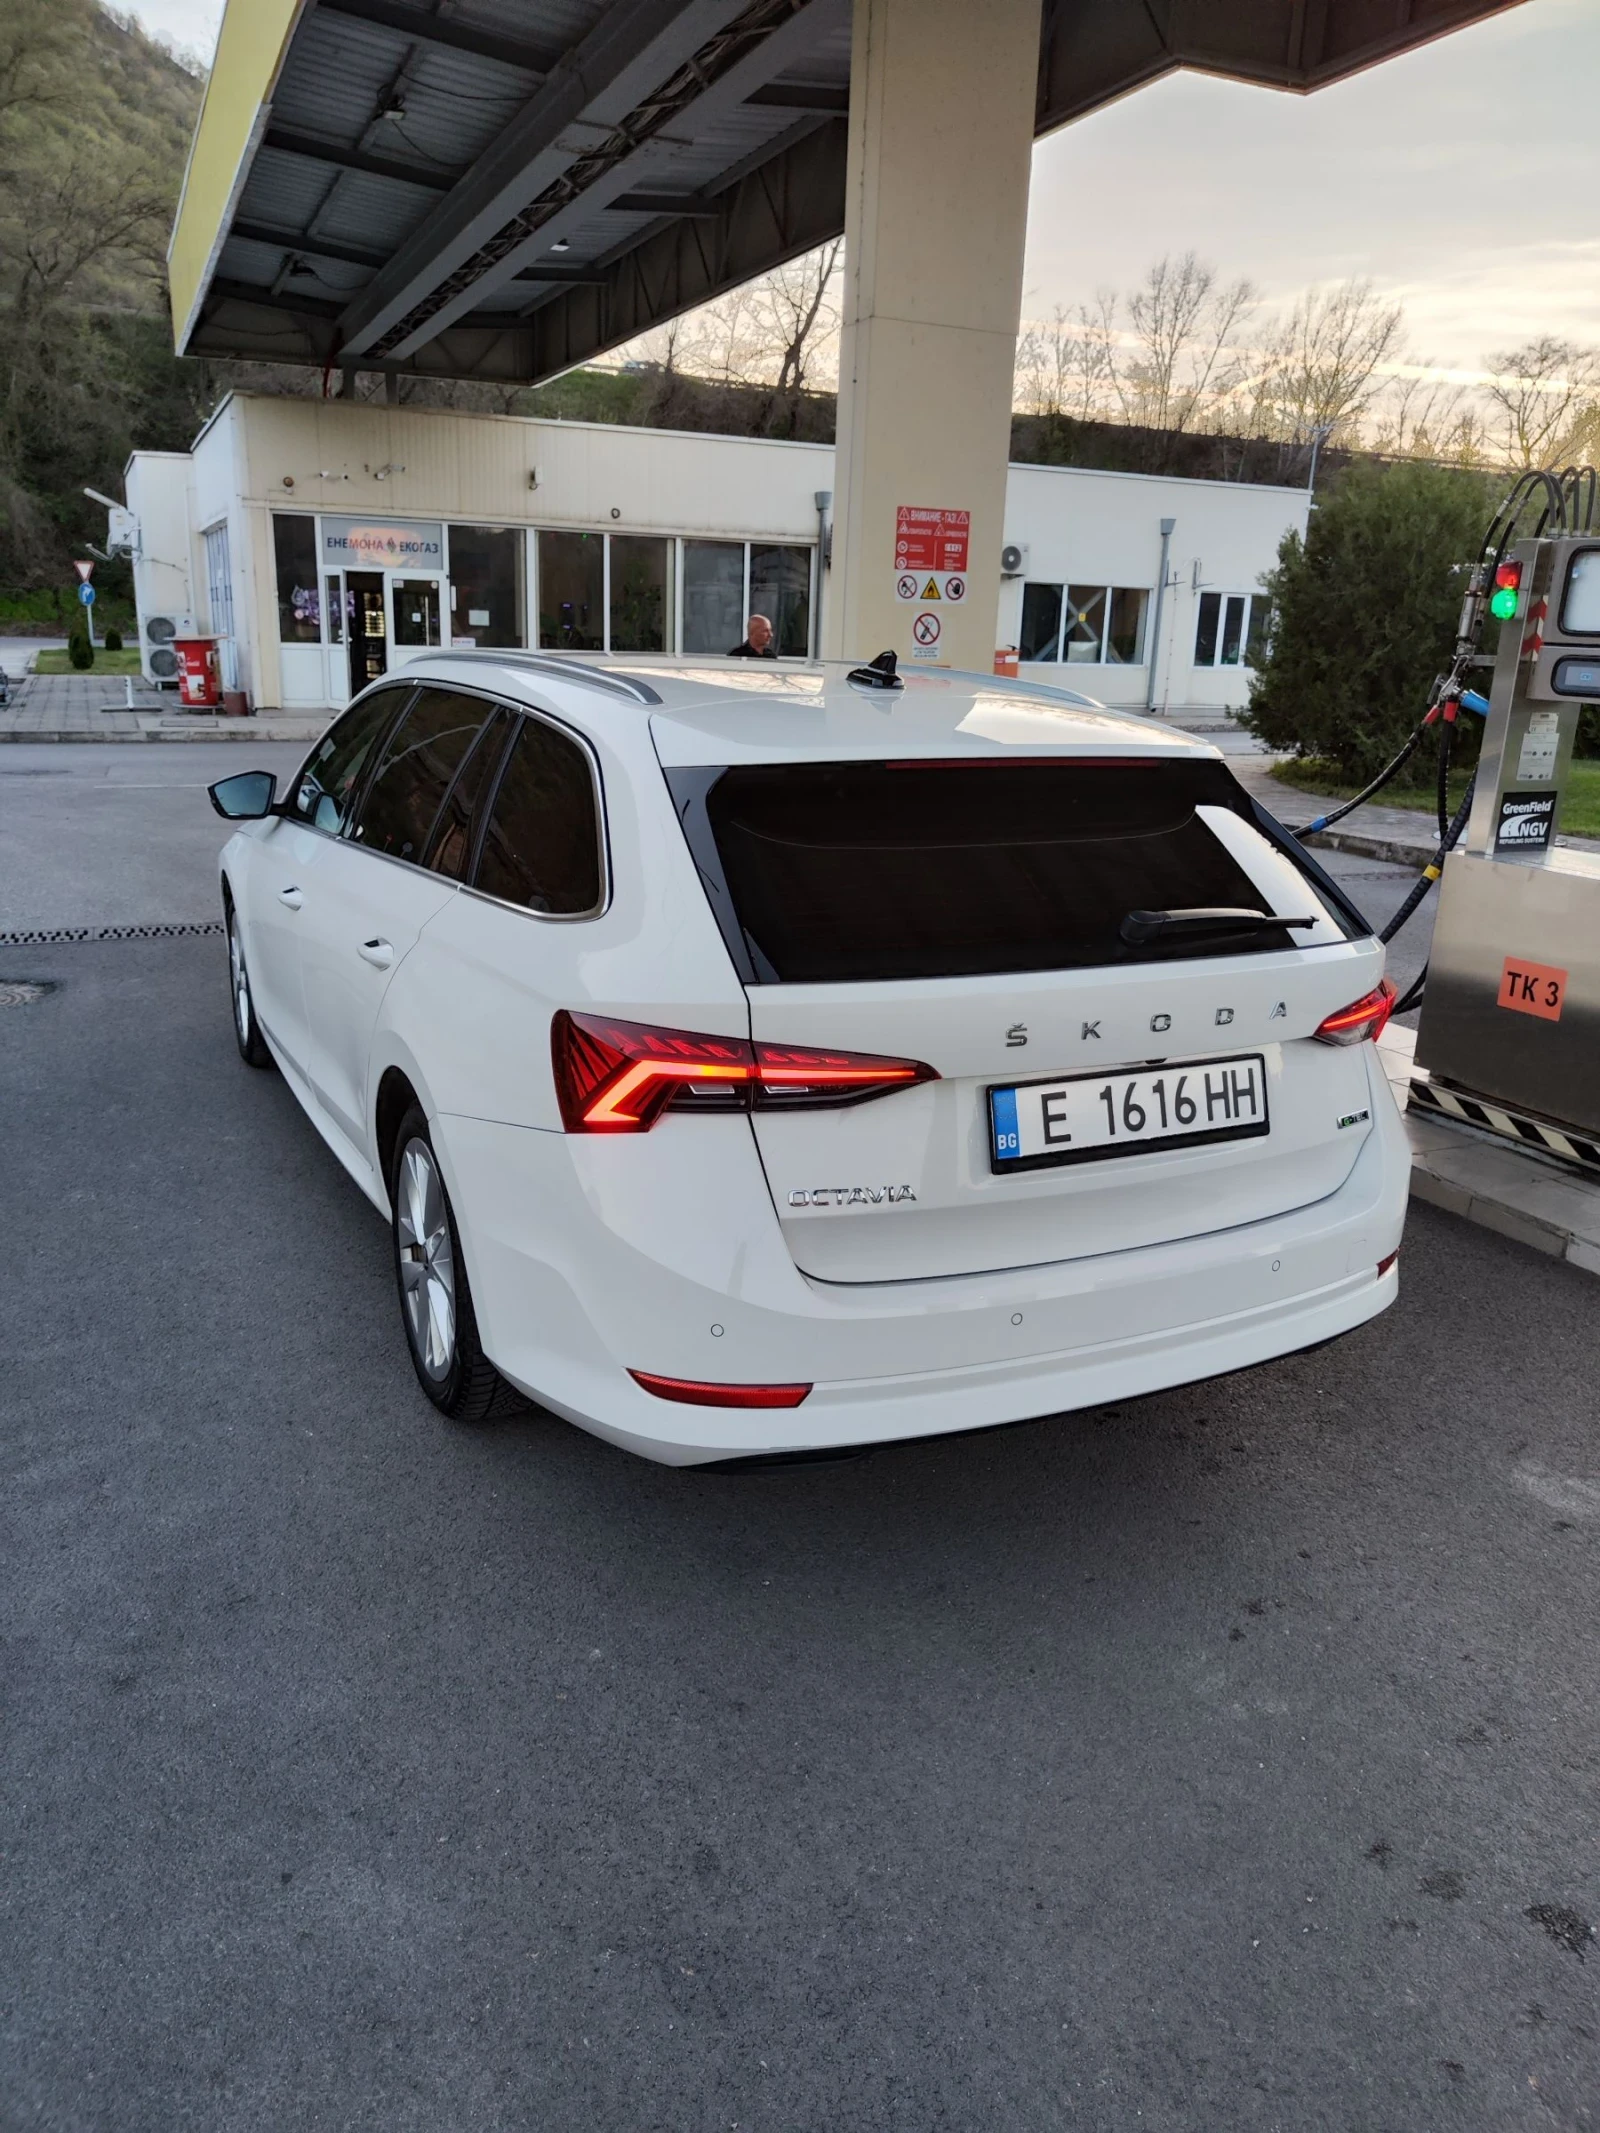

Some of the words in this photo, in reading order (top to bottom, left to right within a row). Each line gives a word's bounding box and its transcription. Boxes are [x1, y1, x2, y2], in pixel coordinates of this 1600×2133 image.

[327, 537, 384, 551] ЕНЕМОНА
[399, 541, 438, 554] ЕКОГАЗ
[1502, 801, 1552, 815] GreenField
[1519, 822, 1549, 837] NGV
[1545, 981, 1559, 1007] 3
[1005, 1000, 1288, 1048] ŠKODA
[1041, 1091, 1072, 1144] E
[997, 1132, 1018, 1150] BG
[788, 1184, 918, 1208] OCTAVIA
